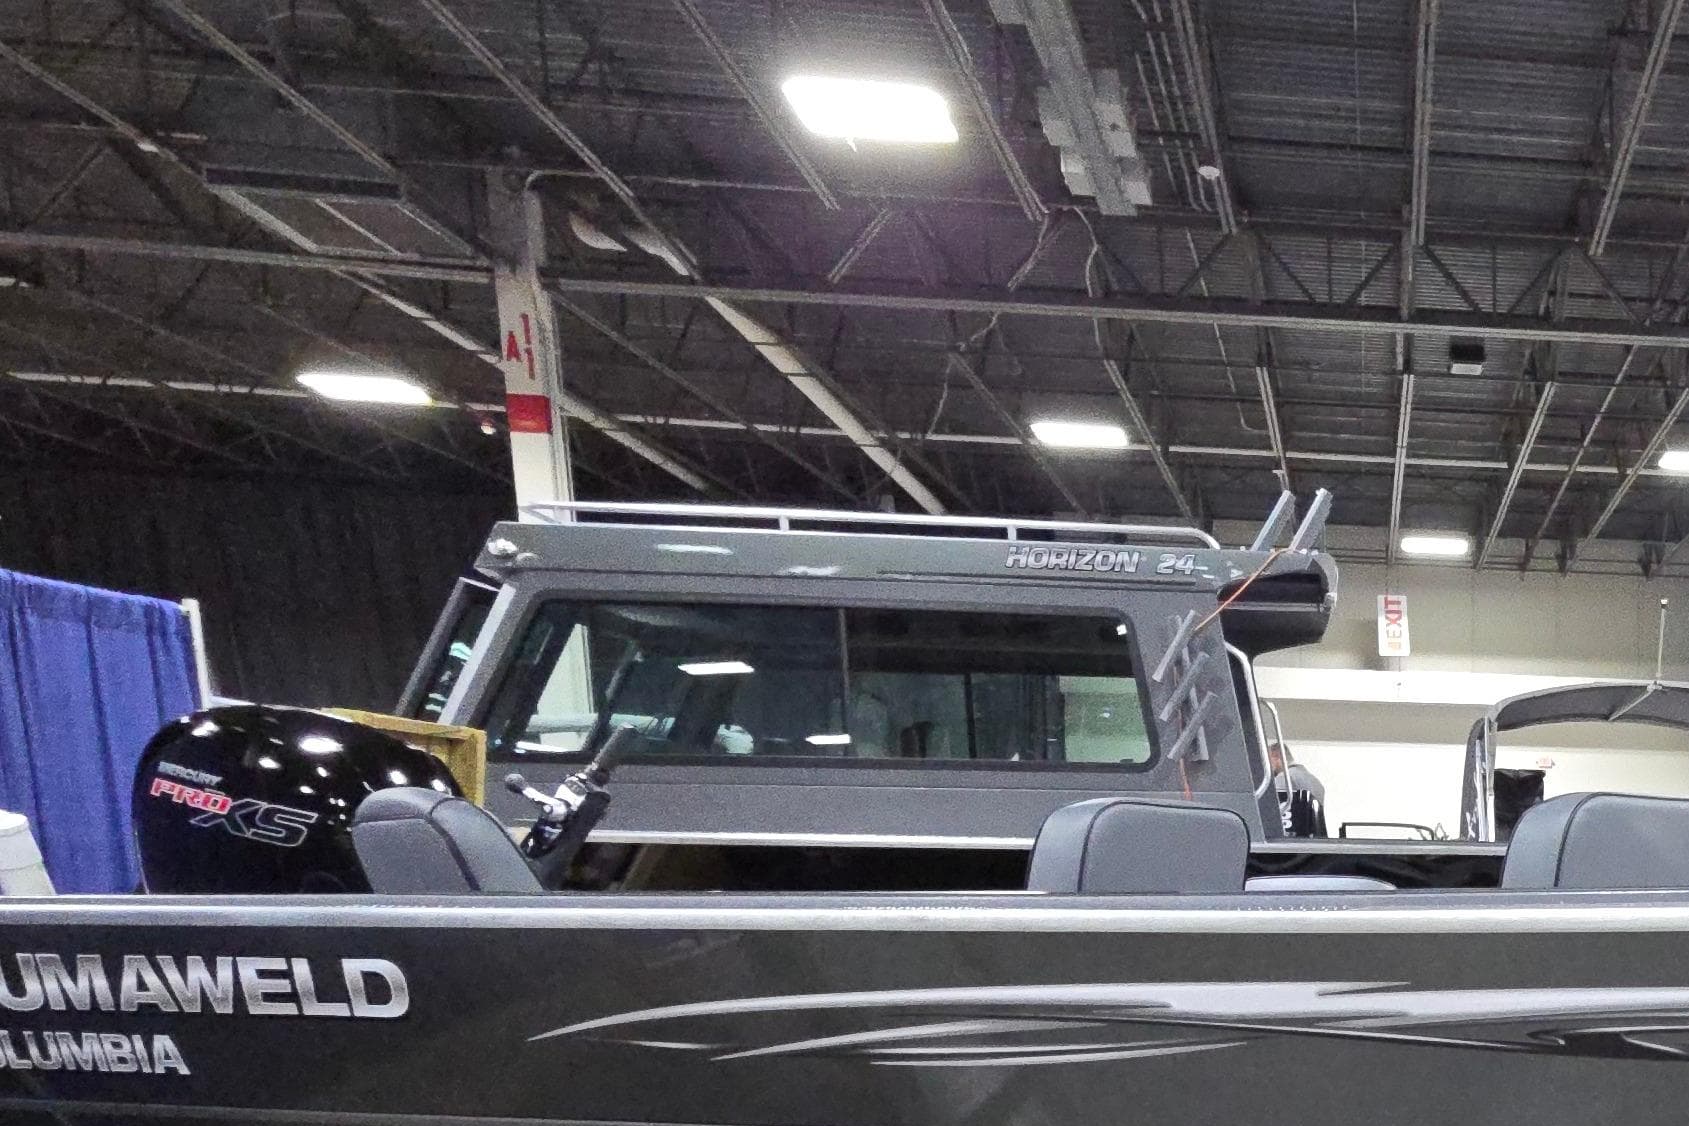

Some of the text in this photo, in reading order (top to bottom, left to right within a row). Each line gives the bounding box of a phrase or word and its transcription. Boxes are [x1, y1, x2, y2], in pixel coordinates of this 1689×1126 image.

[1005, 546, 1195, 575] HORIZON 24
[1384, 596, 1402, 639] EXIT
[150, 777, 319, 848] PRO XS
[0, 1029, 192, 1076] LUMBIA
